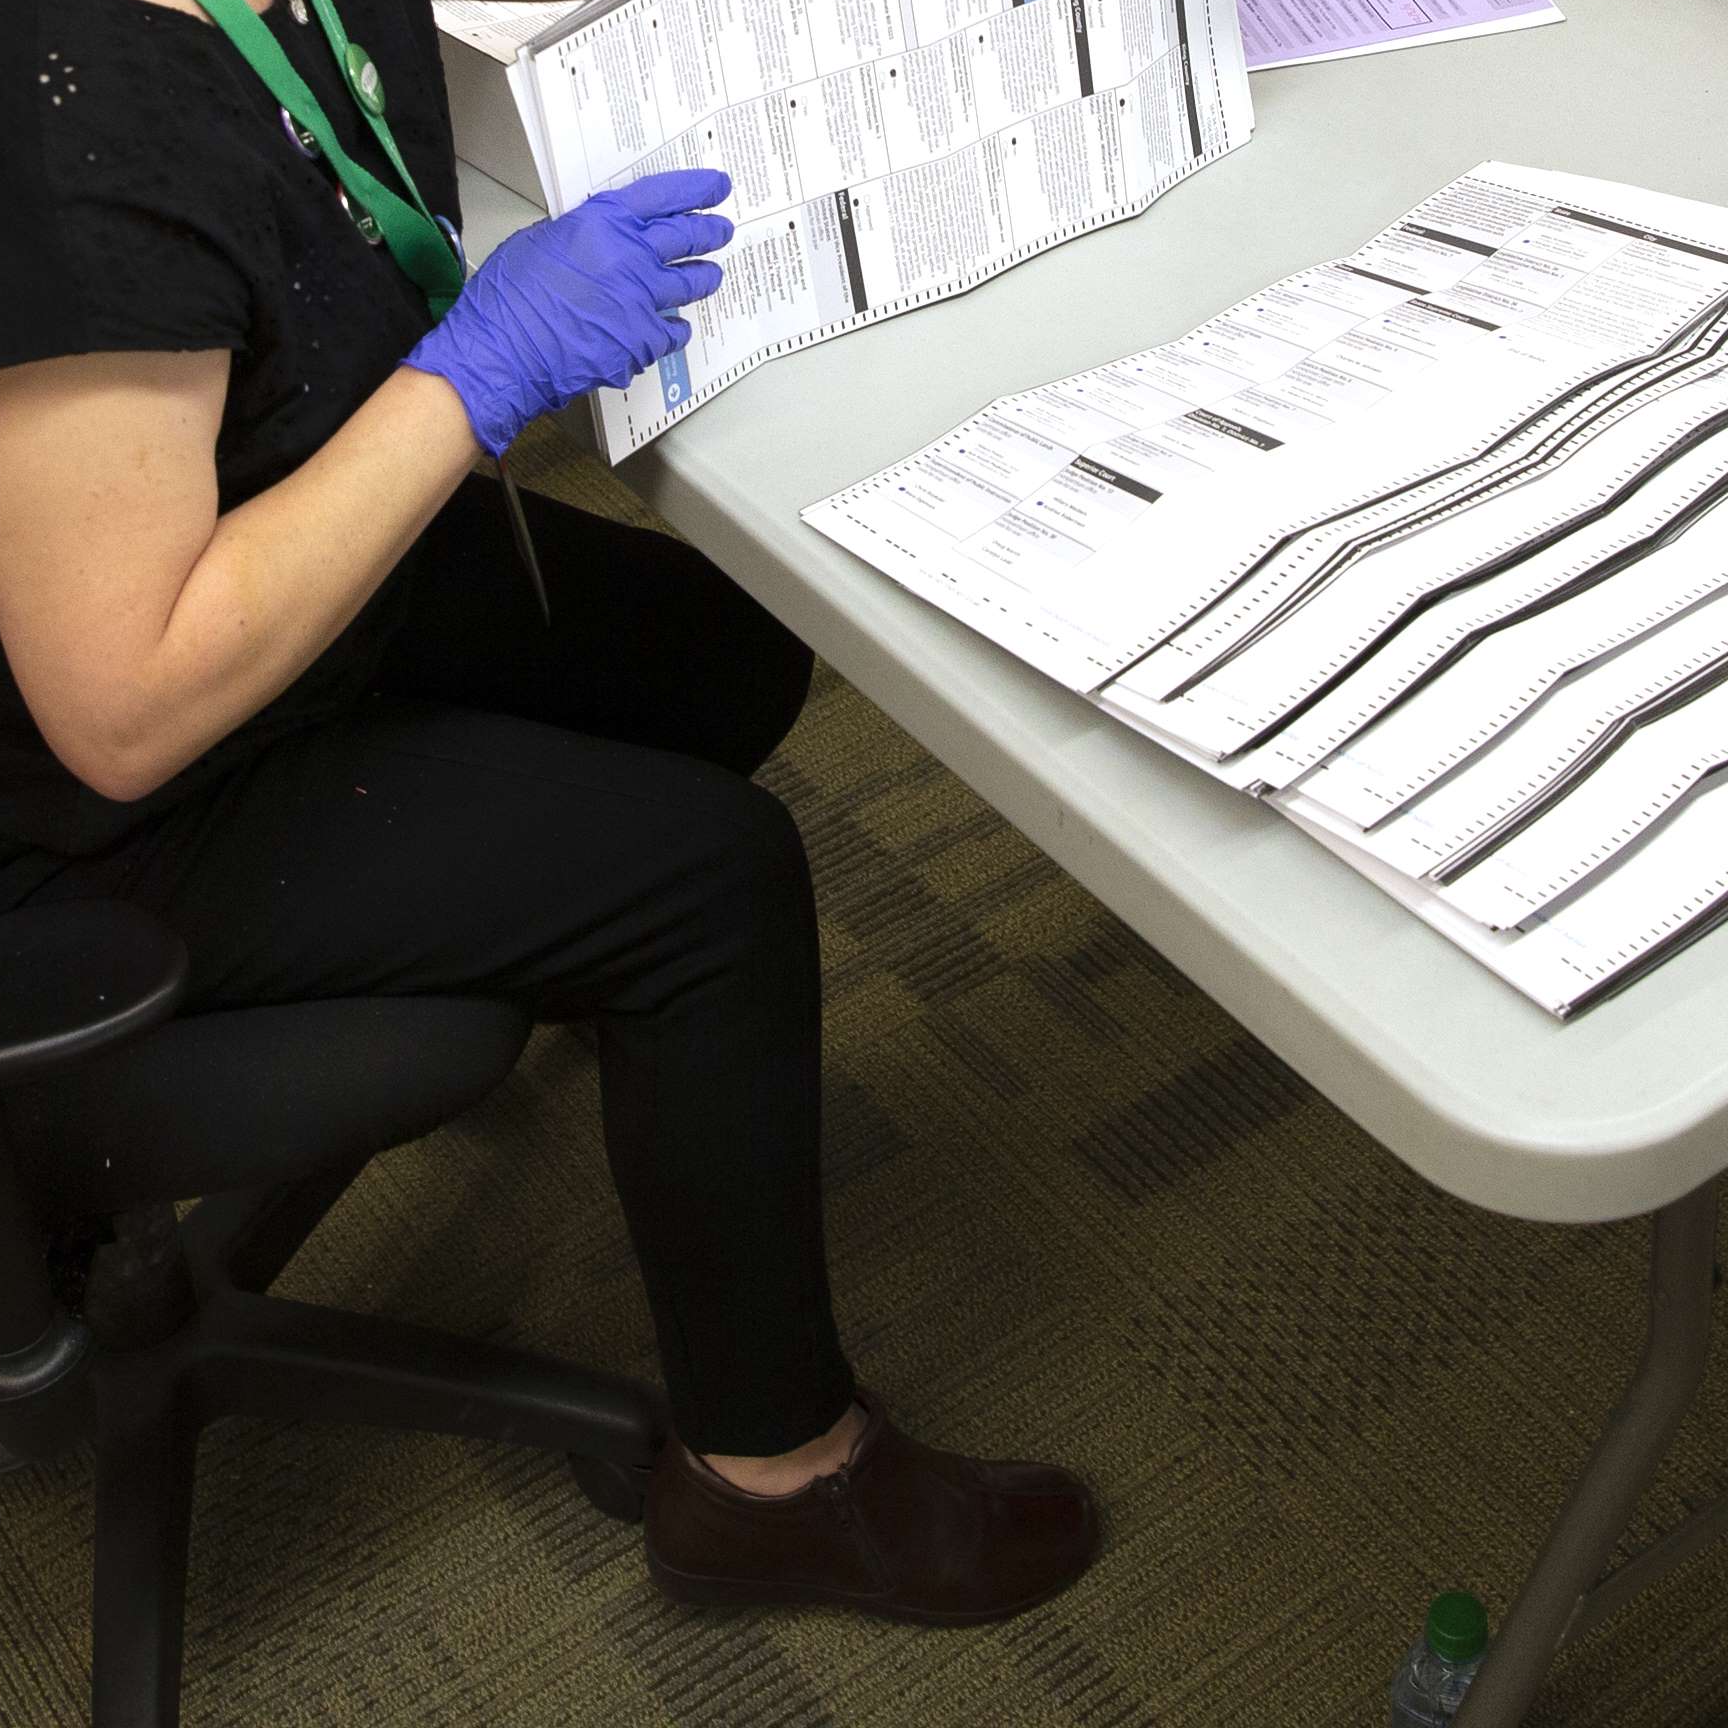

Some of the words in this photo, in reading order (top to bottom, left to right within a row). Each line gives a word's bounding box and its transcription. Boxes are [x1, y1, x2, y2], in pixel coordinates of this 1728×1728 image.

[1072, 6, 1084, 34] County
[1179, 43, 1187, 60] King
[1181, 61, 1191, 86] County
[819, 197, 829, 220] United
[827, 195, 837, 226] President
[837, 191, 849, 219] Federal
[823, 220, 833, 241] States
[832, 226, 840, 239] and
[770, 236, 779, 260] Donald
[834, 240, 842, 253] Vice
[773, 265, 784, 288] Trump
[836, 253, 847, 284] President
[778, 288, 786, 301] and
[842, 284, 849, 292] of
[843, 291, 851, 303] the
[1068, 458, 1102, 473] Superior
[1095, 469, 1121, 481] Court
